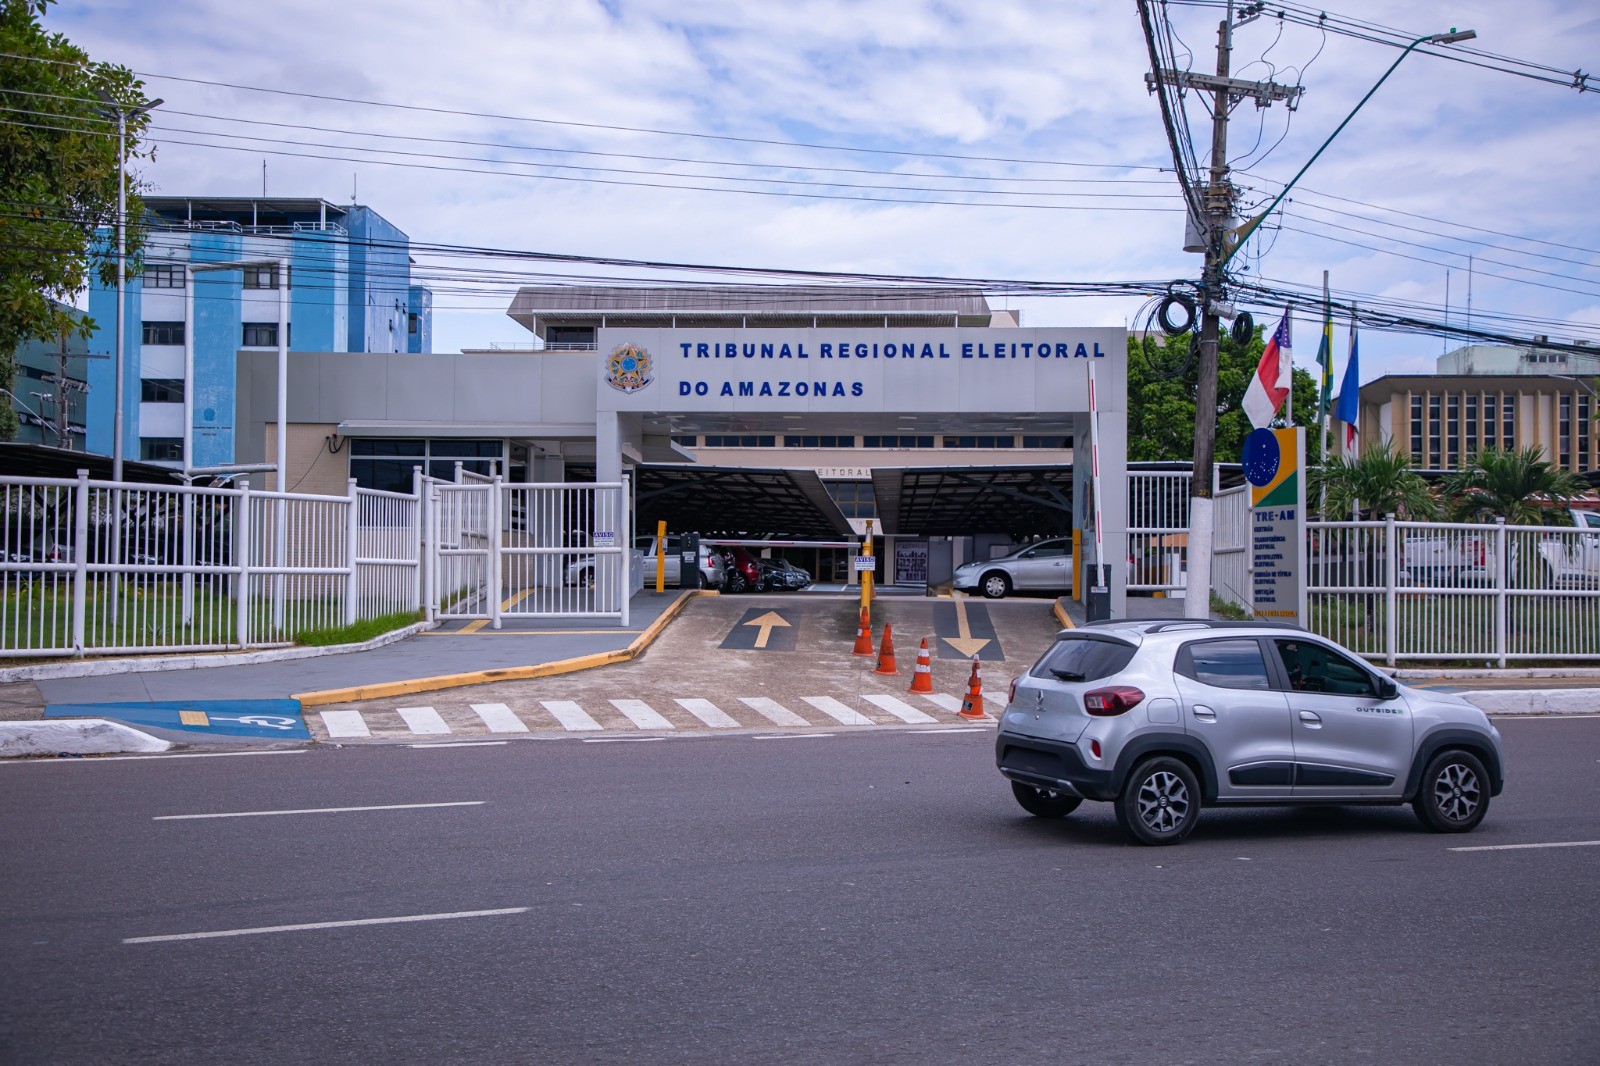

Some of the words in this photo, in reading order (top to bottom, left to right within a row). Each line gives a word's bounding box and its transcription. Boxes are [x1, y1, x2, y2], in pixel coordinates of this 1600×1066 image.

[679, 342, 809, 359] TRIBUNAL
[820, 342, 950, 359] REGIONAL
[961, 342, 1105, 359] ELEITORAL
[679, 381, 709, 397] DO
[720, 381, 864, 397] AMAZONAS
